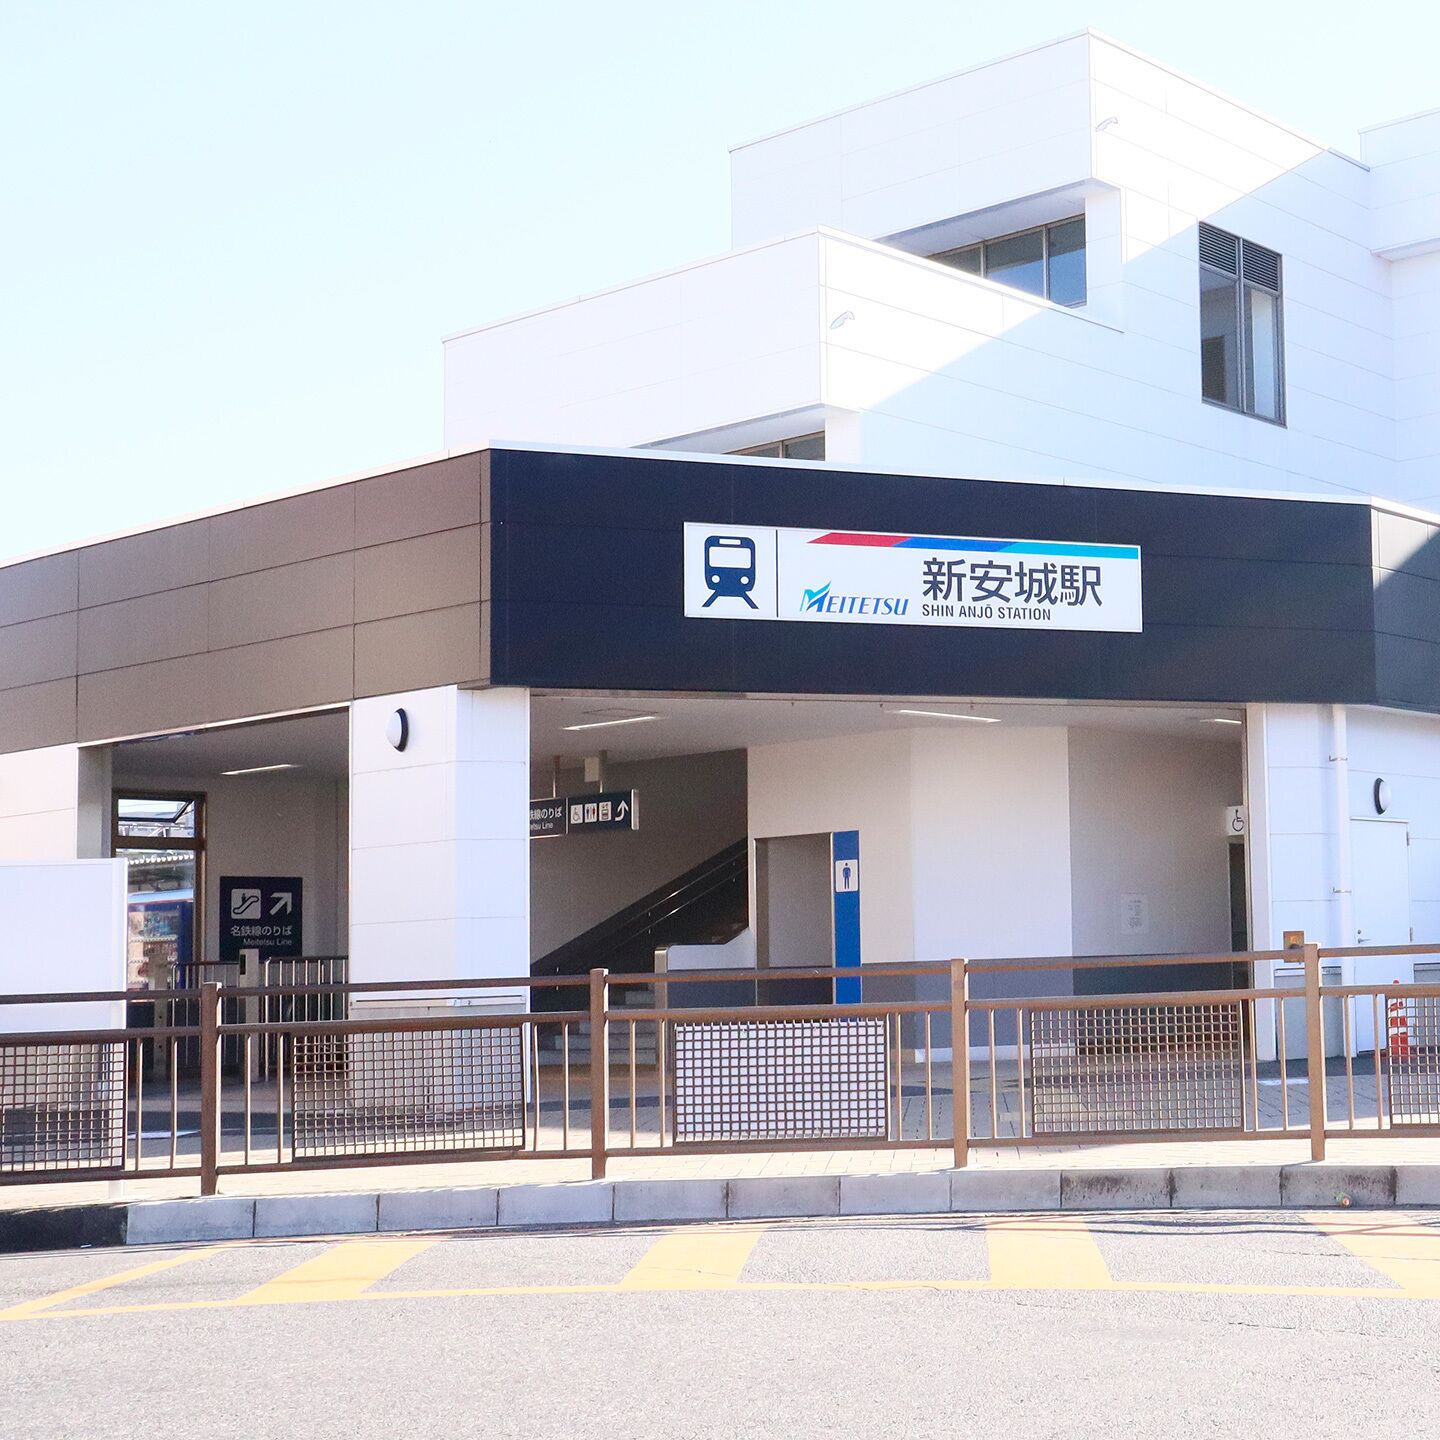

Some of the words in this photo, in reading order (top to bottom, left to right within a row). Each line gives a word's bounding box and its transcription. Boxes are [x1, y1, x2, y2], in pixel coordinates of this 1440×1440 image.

[922, 557, 1103, 607] 新安城駅
[800, 580, 910, 616] MEITETSU
[922, 603, 954, 617] SHIN
[958, 604, 993, 619] ANJŌ
[997, 606, 1051, 621] STATION
[230, 925, 293, 937] 名鉄線のりば
[243, 938, 275, 946] Meitetsu
[276, 938, 293, 946] Line
